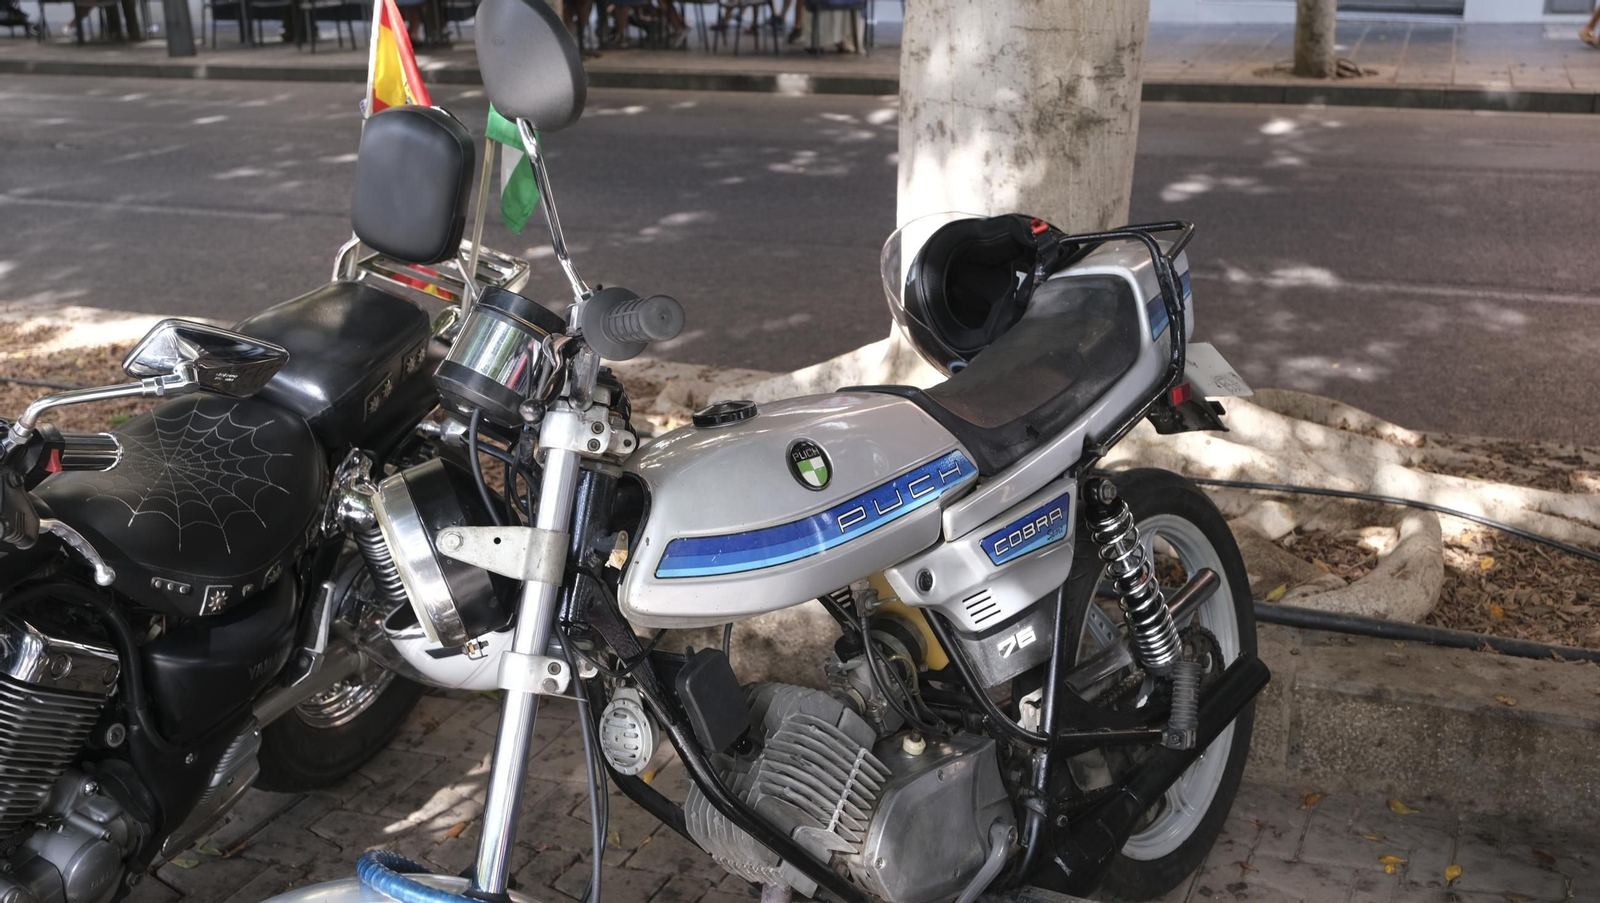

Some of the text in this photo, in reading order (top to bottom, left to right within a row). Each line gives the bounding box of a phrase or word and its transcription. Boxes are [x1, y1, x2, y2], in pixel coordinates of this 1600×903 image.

[792, 446, 820, 462] PUCH
[837, 460, 962, 533] PUCH
[993, 507, 1063, 556] COBRA
